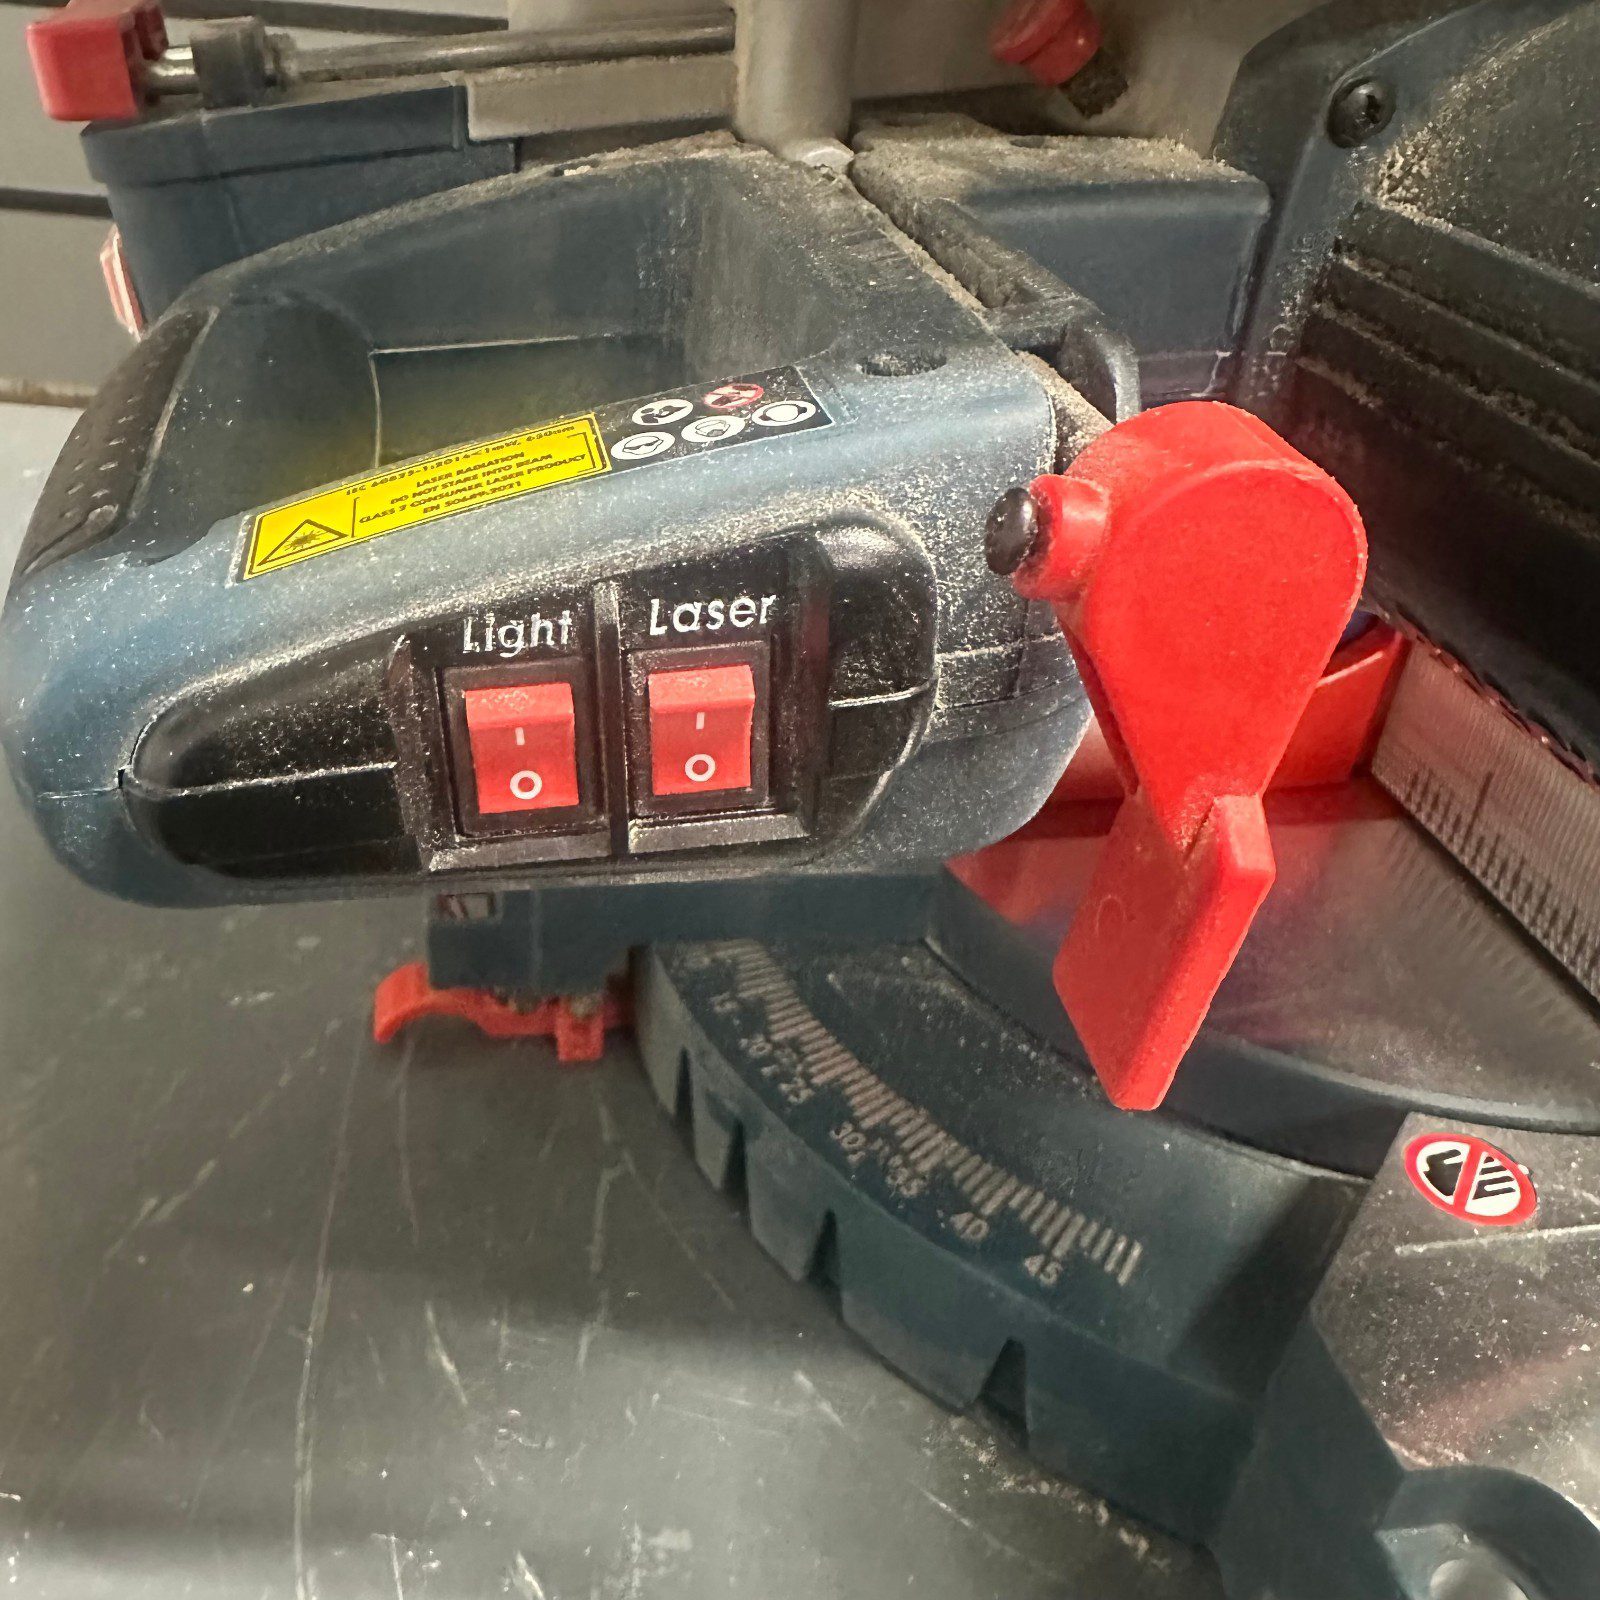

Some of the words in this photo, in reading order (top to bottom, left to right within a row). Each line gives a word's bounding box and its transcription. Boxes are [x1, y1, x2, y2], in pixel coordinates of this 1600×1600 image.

[359, 507, 396, 524] CLASS
[399, 503, 407, 512] 2
[409, 482, 484, 508] CONSUMER
[486, 470, 525, 486] LASER
[526, 453, 586, 475] PRODUCT
[390, 494, 409, 505] DO
[412, 485, 439, 499] NOT
[441, 473, 479, 490] STARE
[482, 464, 513, 478] INTO
[515, 453, 553, 469] BEAM
[416, 472, 453, 488] LASER
[456, 451, 525, 476] RADIATION
[422, 503, 441, 514] EN
[462, 609, 573, 658] Light
[648, 594, 777, 636] Laser
[949, 1211, 990, 1242] 40
[1023, 1253, 1063, 1287] 45
